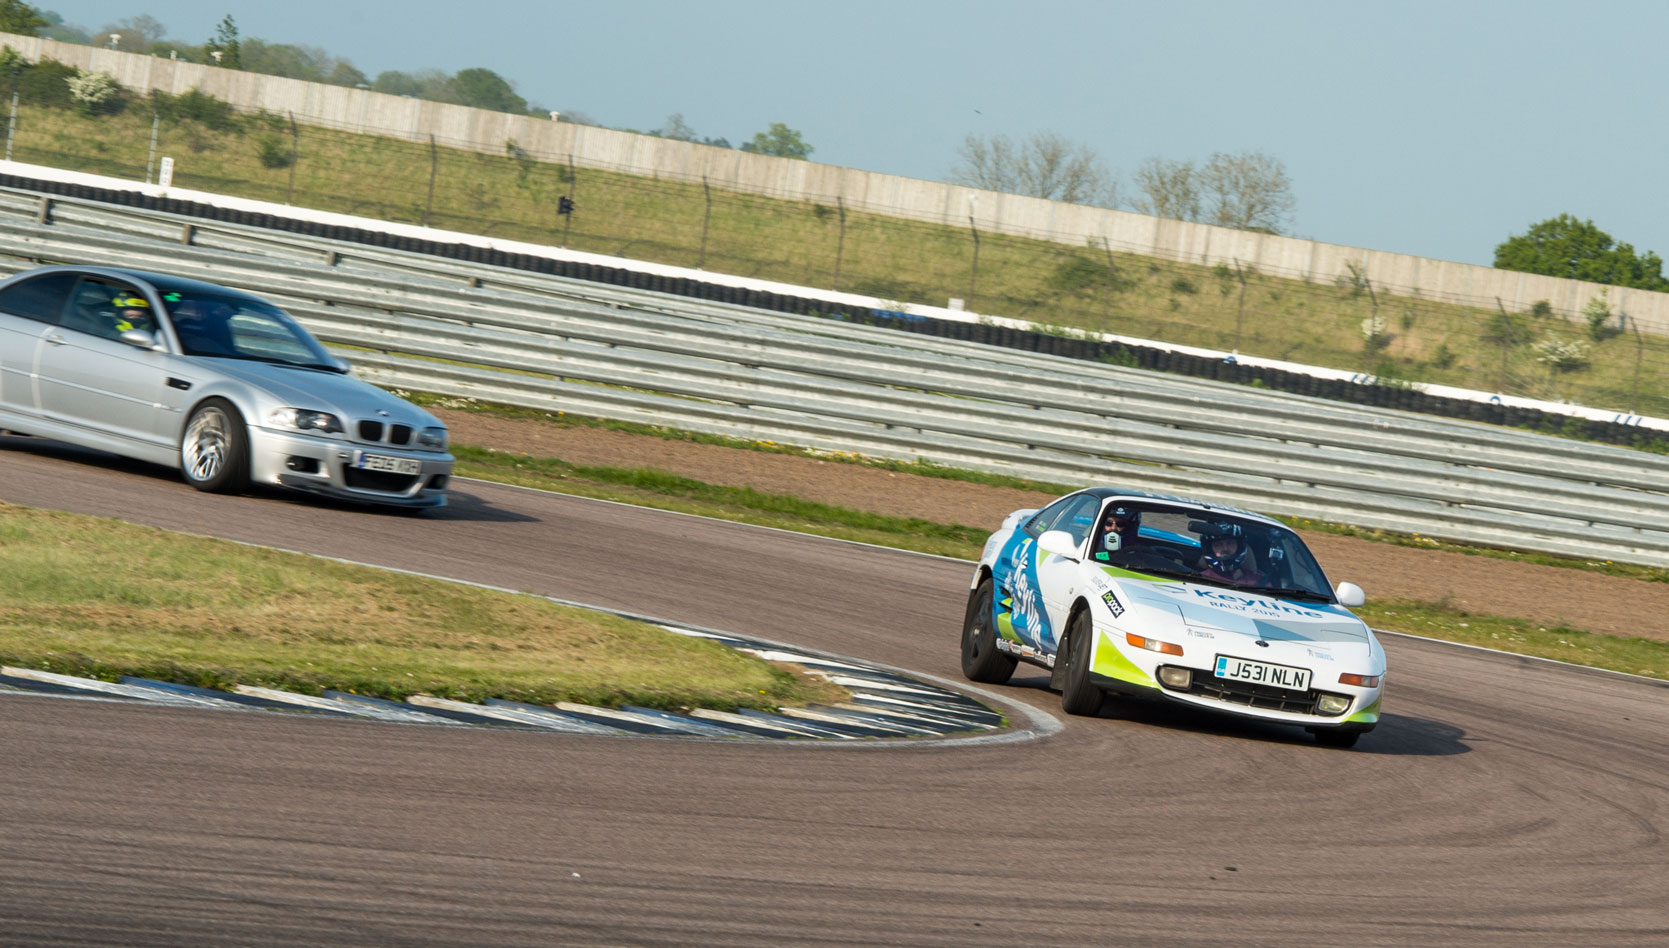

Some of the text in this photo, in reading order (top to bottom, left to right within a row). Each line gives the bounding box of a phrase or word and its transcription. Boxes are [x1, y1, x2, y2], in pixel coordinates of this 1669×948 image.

[1193, 588, 1324, 619] Keyline
[1209, 601, 1281, 619] RALLY 2015
[1230, 662, 1305, 688] J531 NLN
